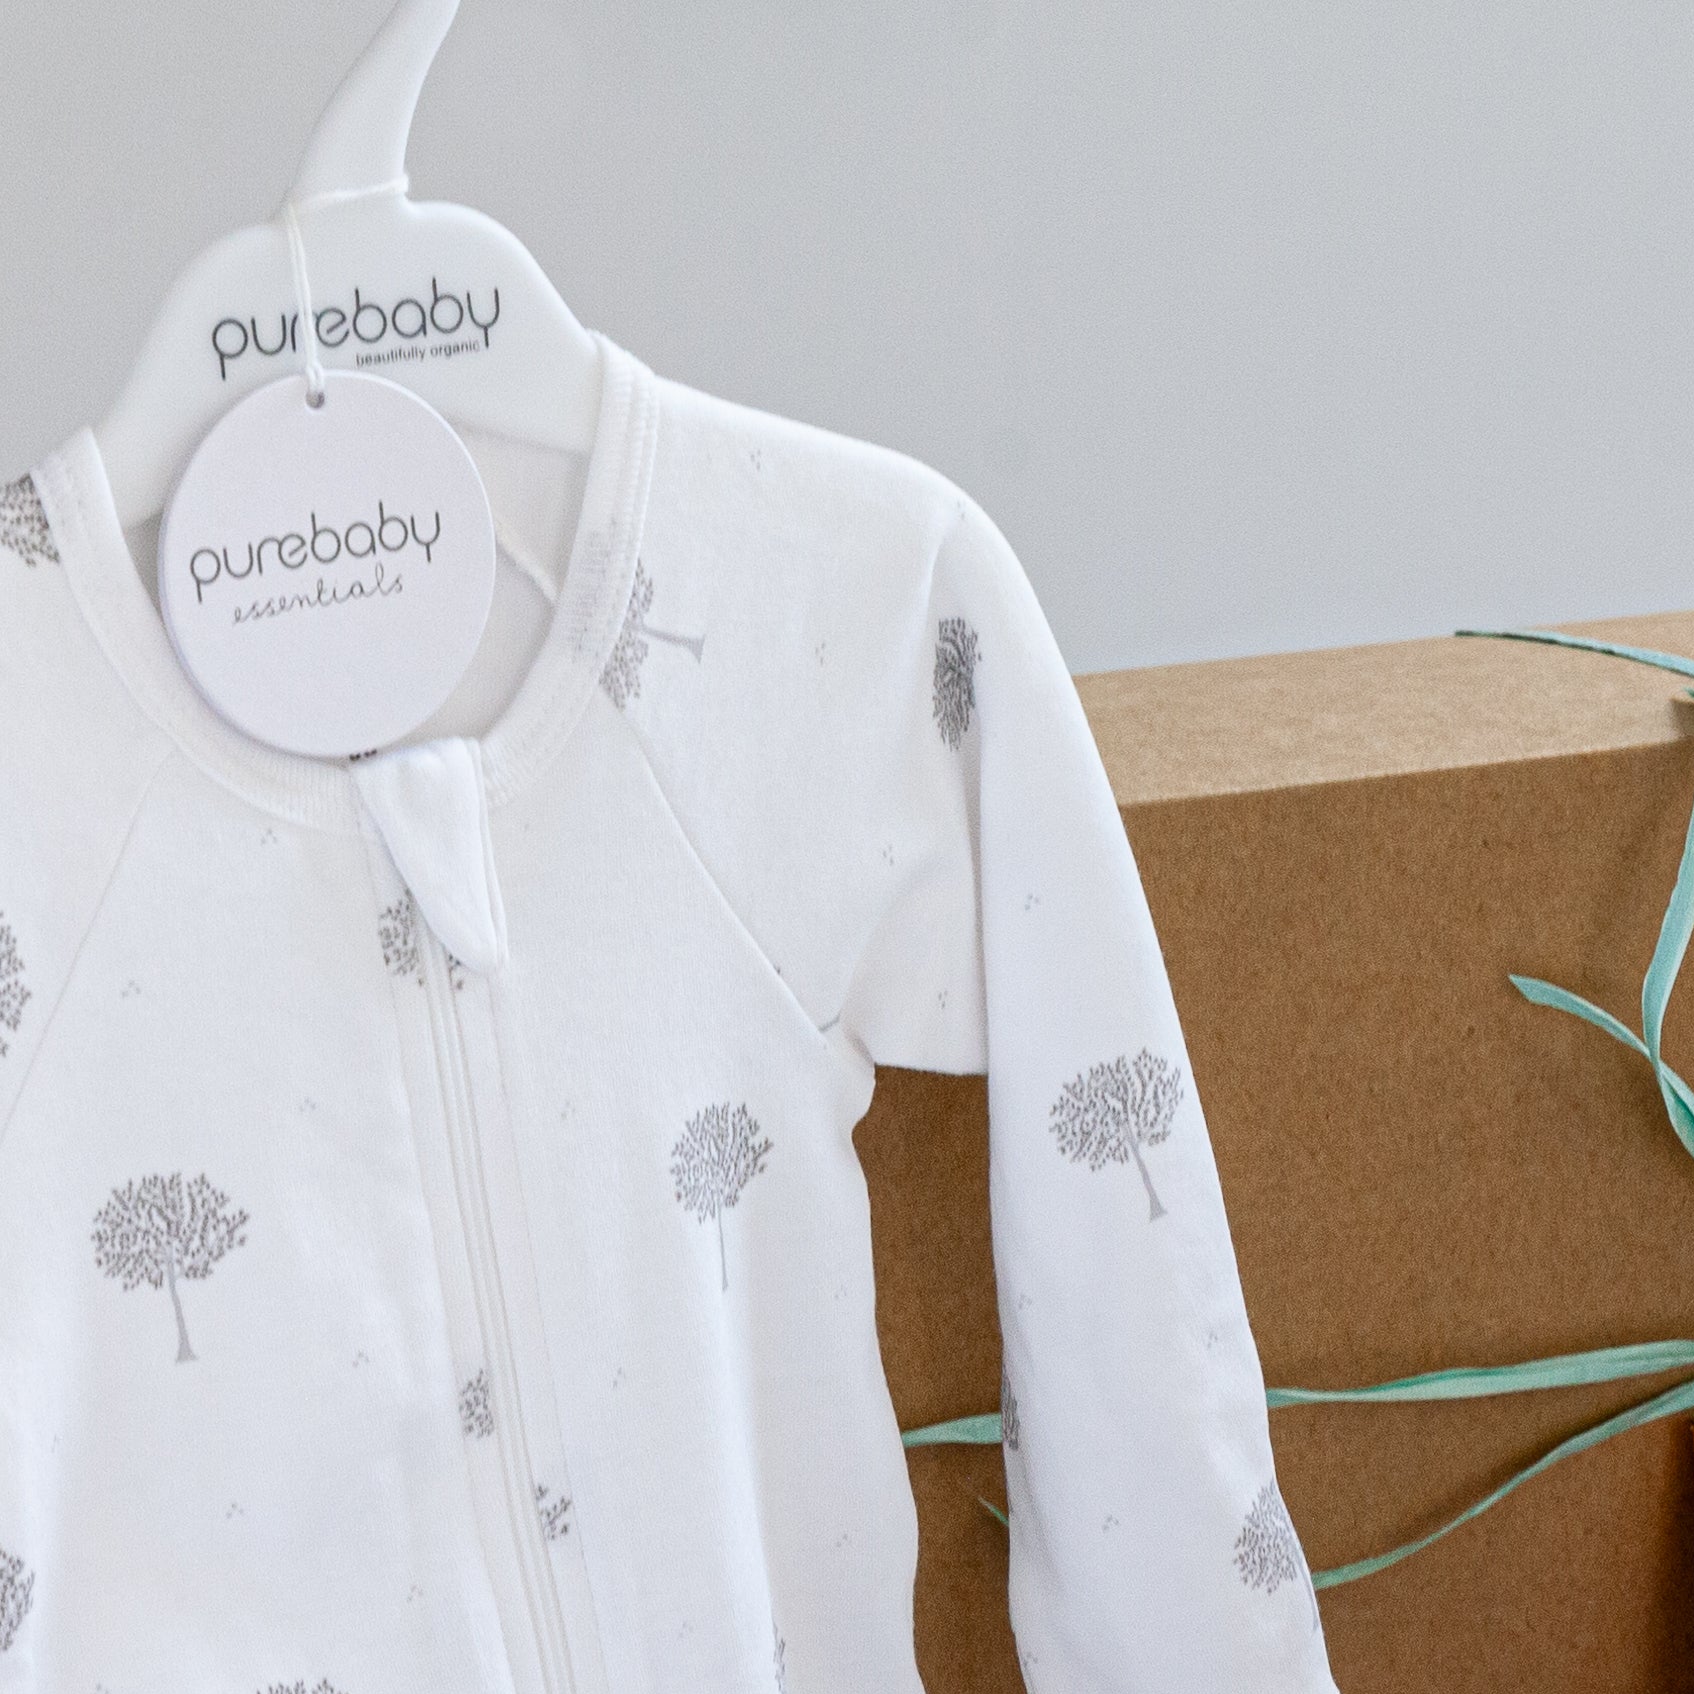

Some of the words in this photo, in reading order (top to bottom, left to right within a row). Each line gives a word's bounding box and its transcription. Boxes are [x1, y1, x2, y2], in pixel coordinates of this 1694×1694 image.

[211, 276, 501, 381] purebaby
[355, 345, 427, 368] beautifully
[429, 339, 481, 357] organic
[189, 499, 441, 604] purebaby
[231, 561, 404, 627] essentials
